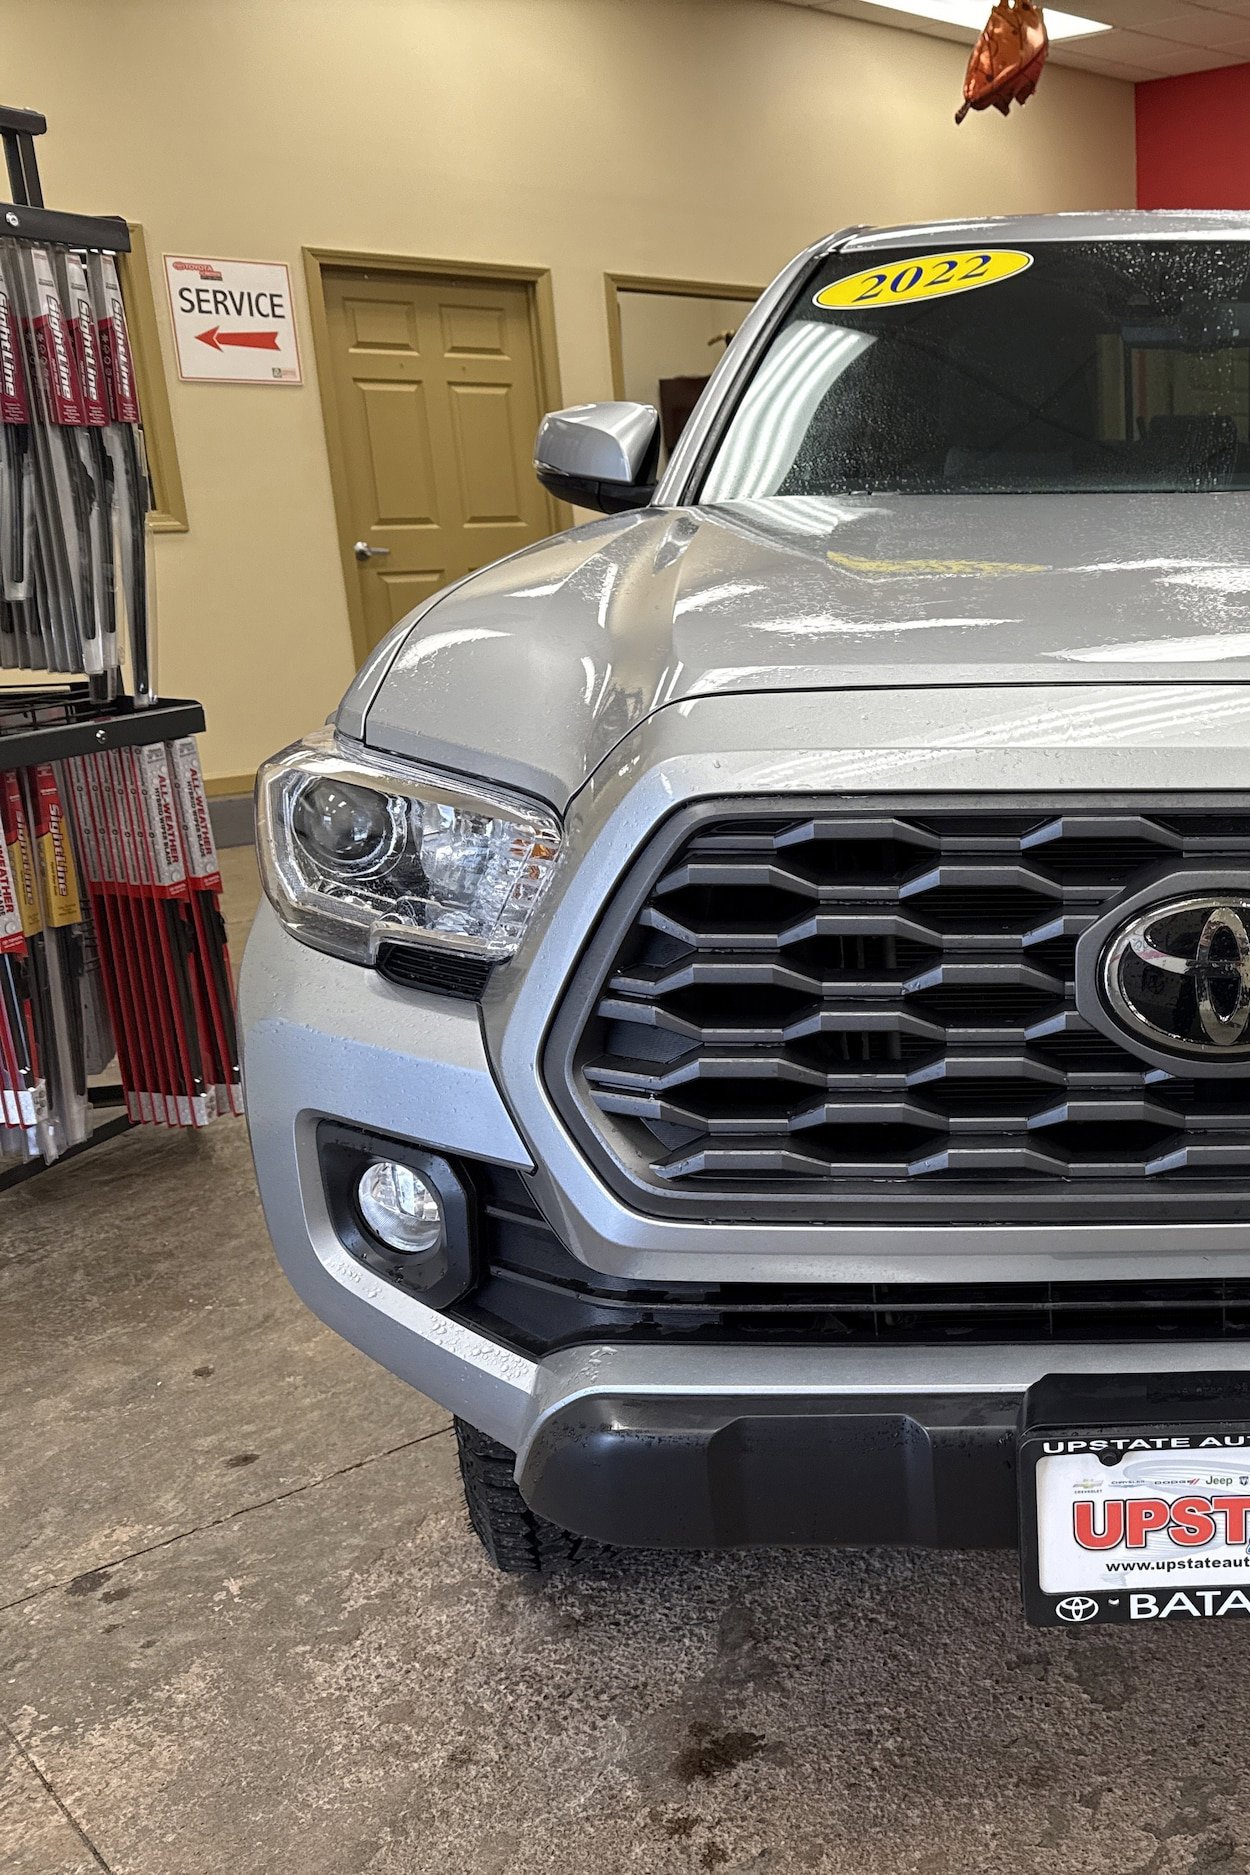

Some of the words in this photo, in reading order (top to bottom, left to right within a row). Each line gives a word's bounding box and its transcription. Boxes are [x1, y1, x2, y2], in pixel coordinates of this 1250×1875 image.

[178, 287, 286, 319] SERVICE
[852, 255, 991, 303] 2022
[47, 295, 71, 400] SightLine
[78, 299, 98, 400] SightLine
[112, 298, 130, 398] SightLine
[49, 804, 67, 896] SightLine
[158, 775, 179, 864] ALL-WEATHER
[190, 768, 213, 856] ALL-WEATHER
[1043, 1437, 1191, 1454] UPSTATE
[1205, 1476, 1233, 1486] Jeep
